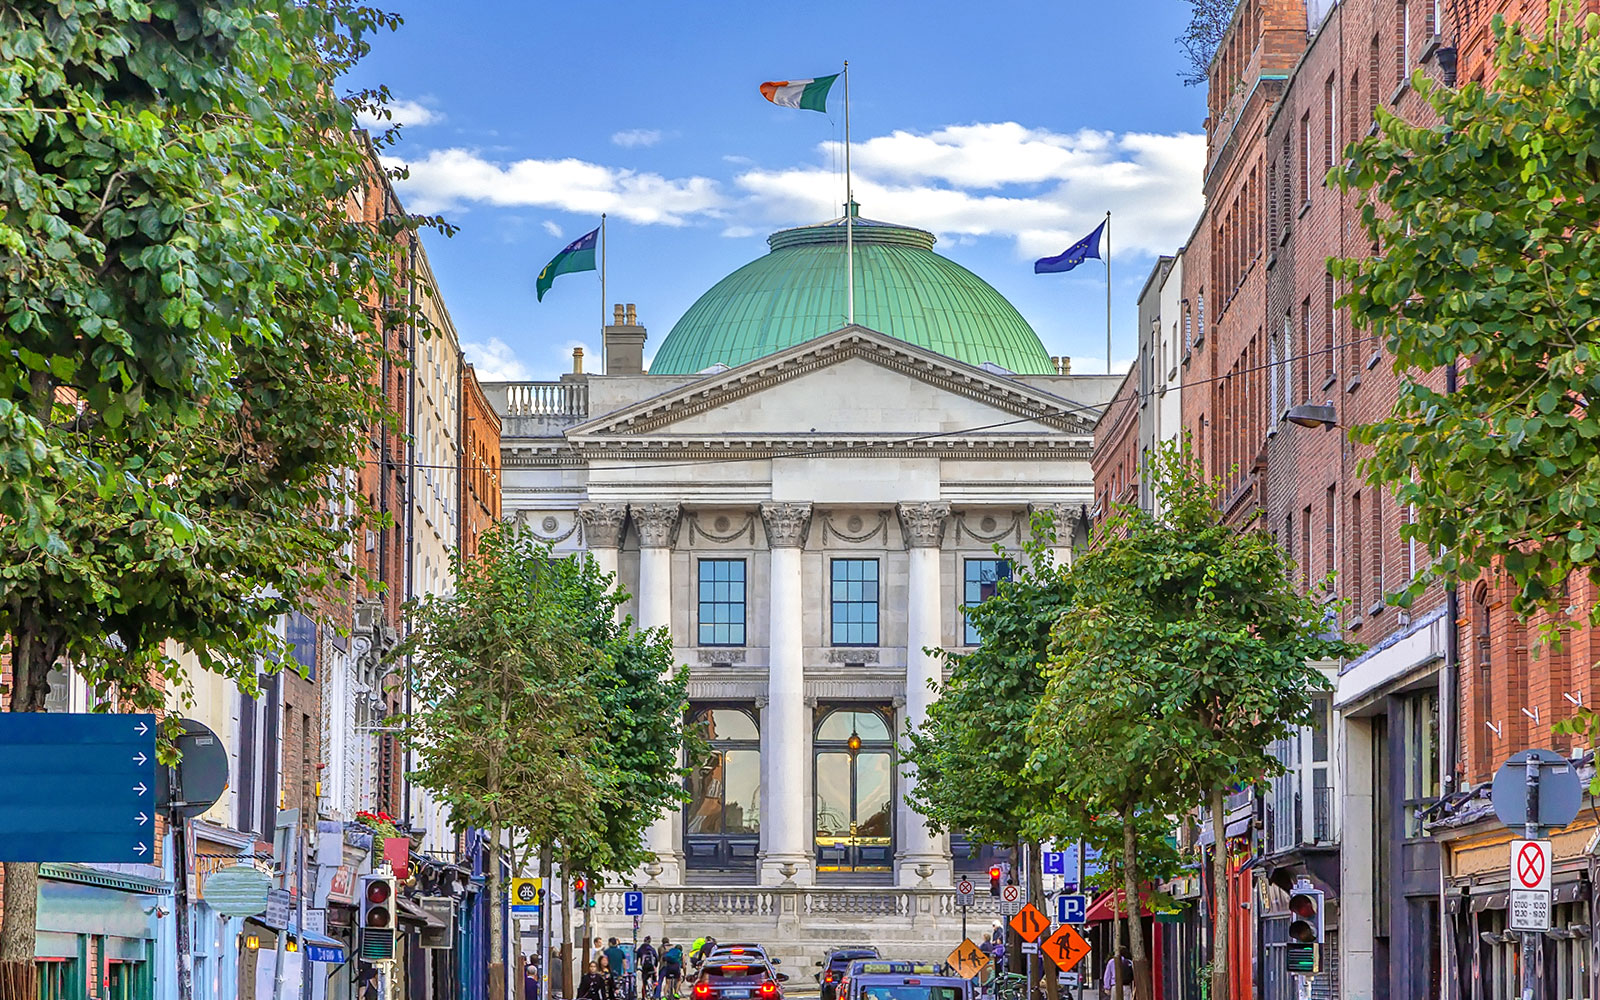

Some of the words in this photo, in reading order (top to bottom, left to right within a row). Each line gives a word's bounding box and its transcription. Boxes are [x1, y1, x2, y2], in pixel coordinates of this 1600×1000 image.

[1049, 854, 1060, 867] P
[630, 894, 638, 906] P
[1064, 899, 1079, 920] P
[894, 965, 911, 973] TAXI
